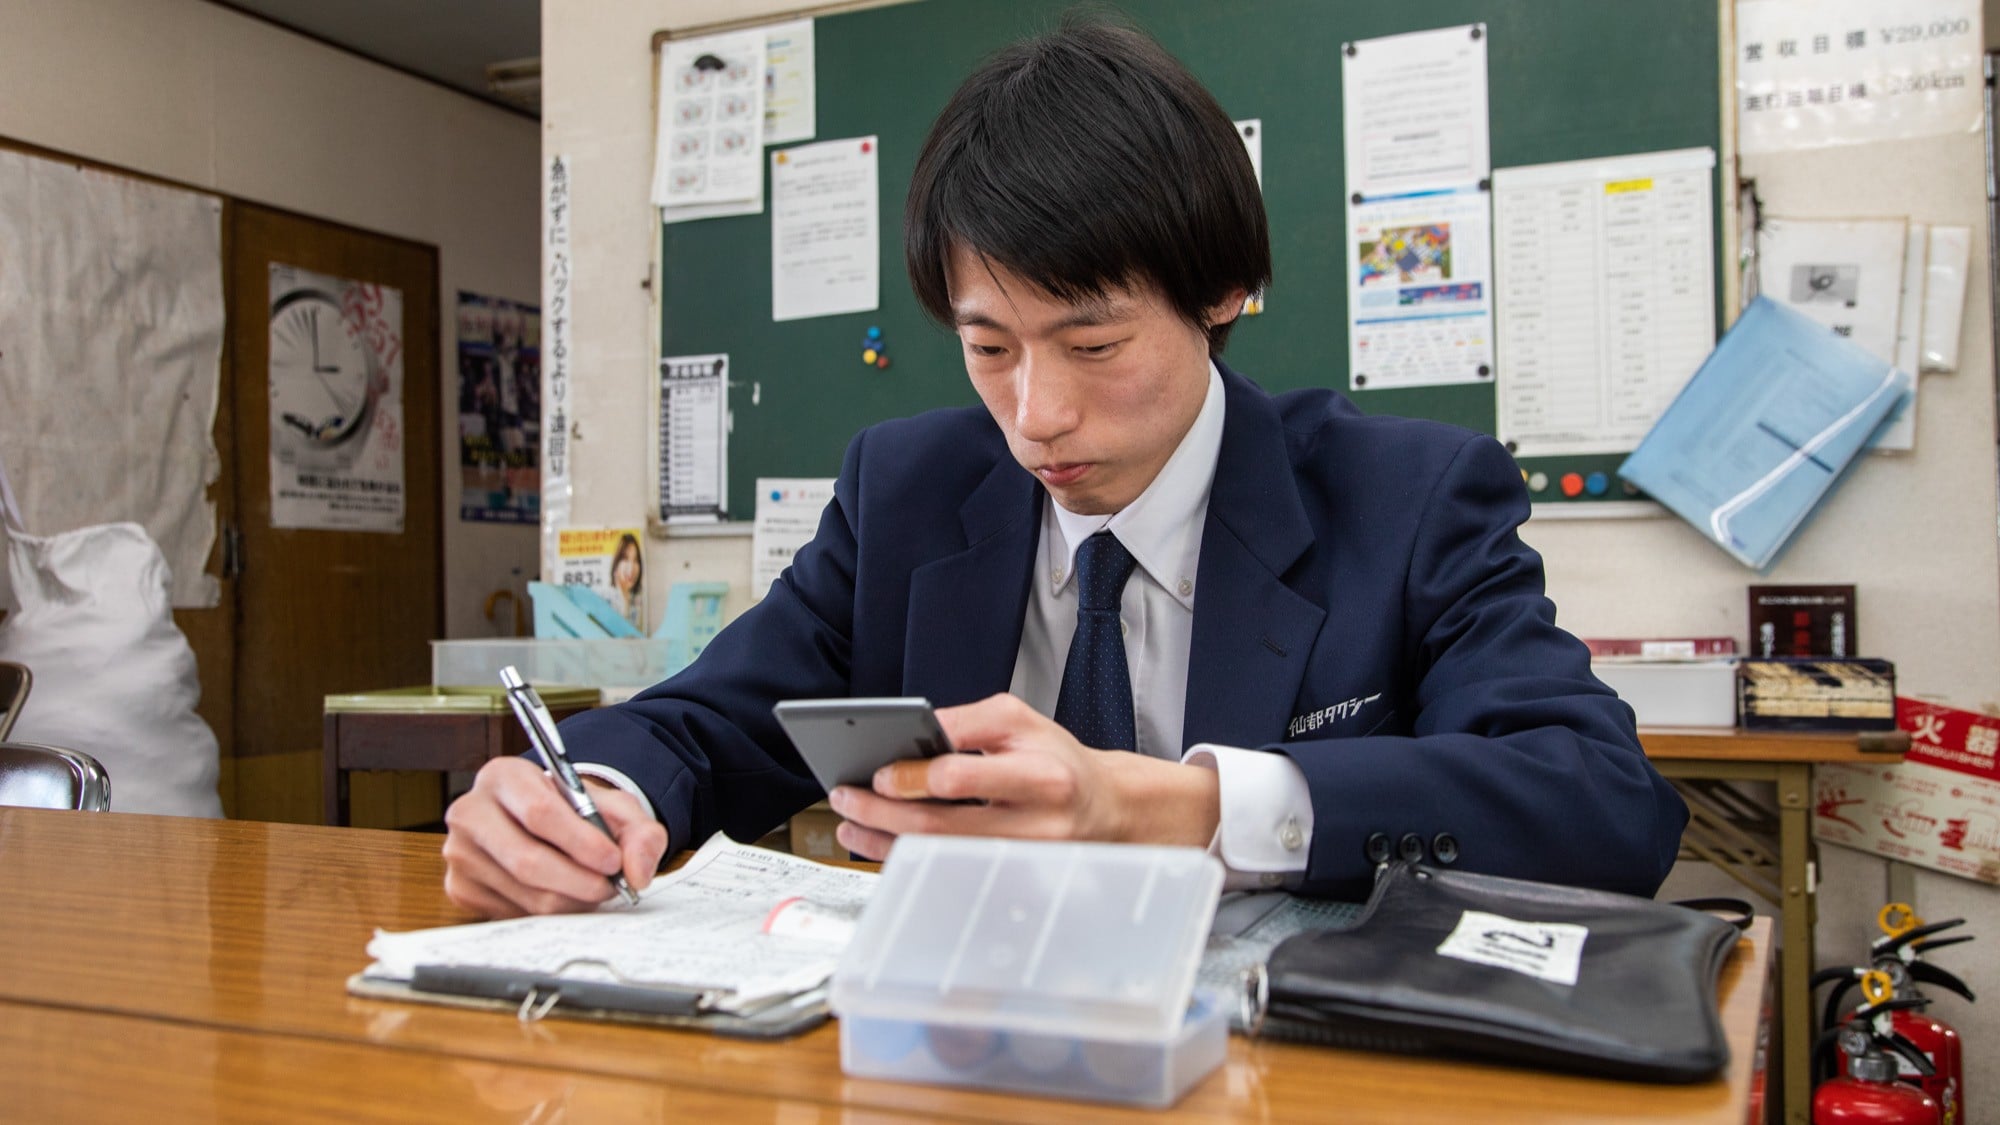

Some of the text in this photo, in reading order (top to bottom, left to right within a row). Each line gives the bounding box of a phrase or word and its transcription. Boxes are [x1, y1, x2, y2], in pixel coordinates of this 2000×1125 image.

[1289, 692, 1382, 738] 仙都タクシー
